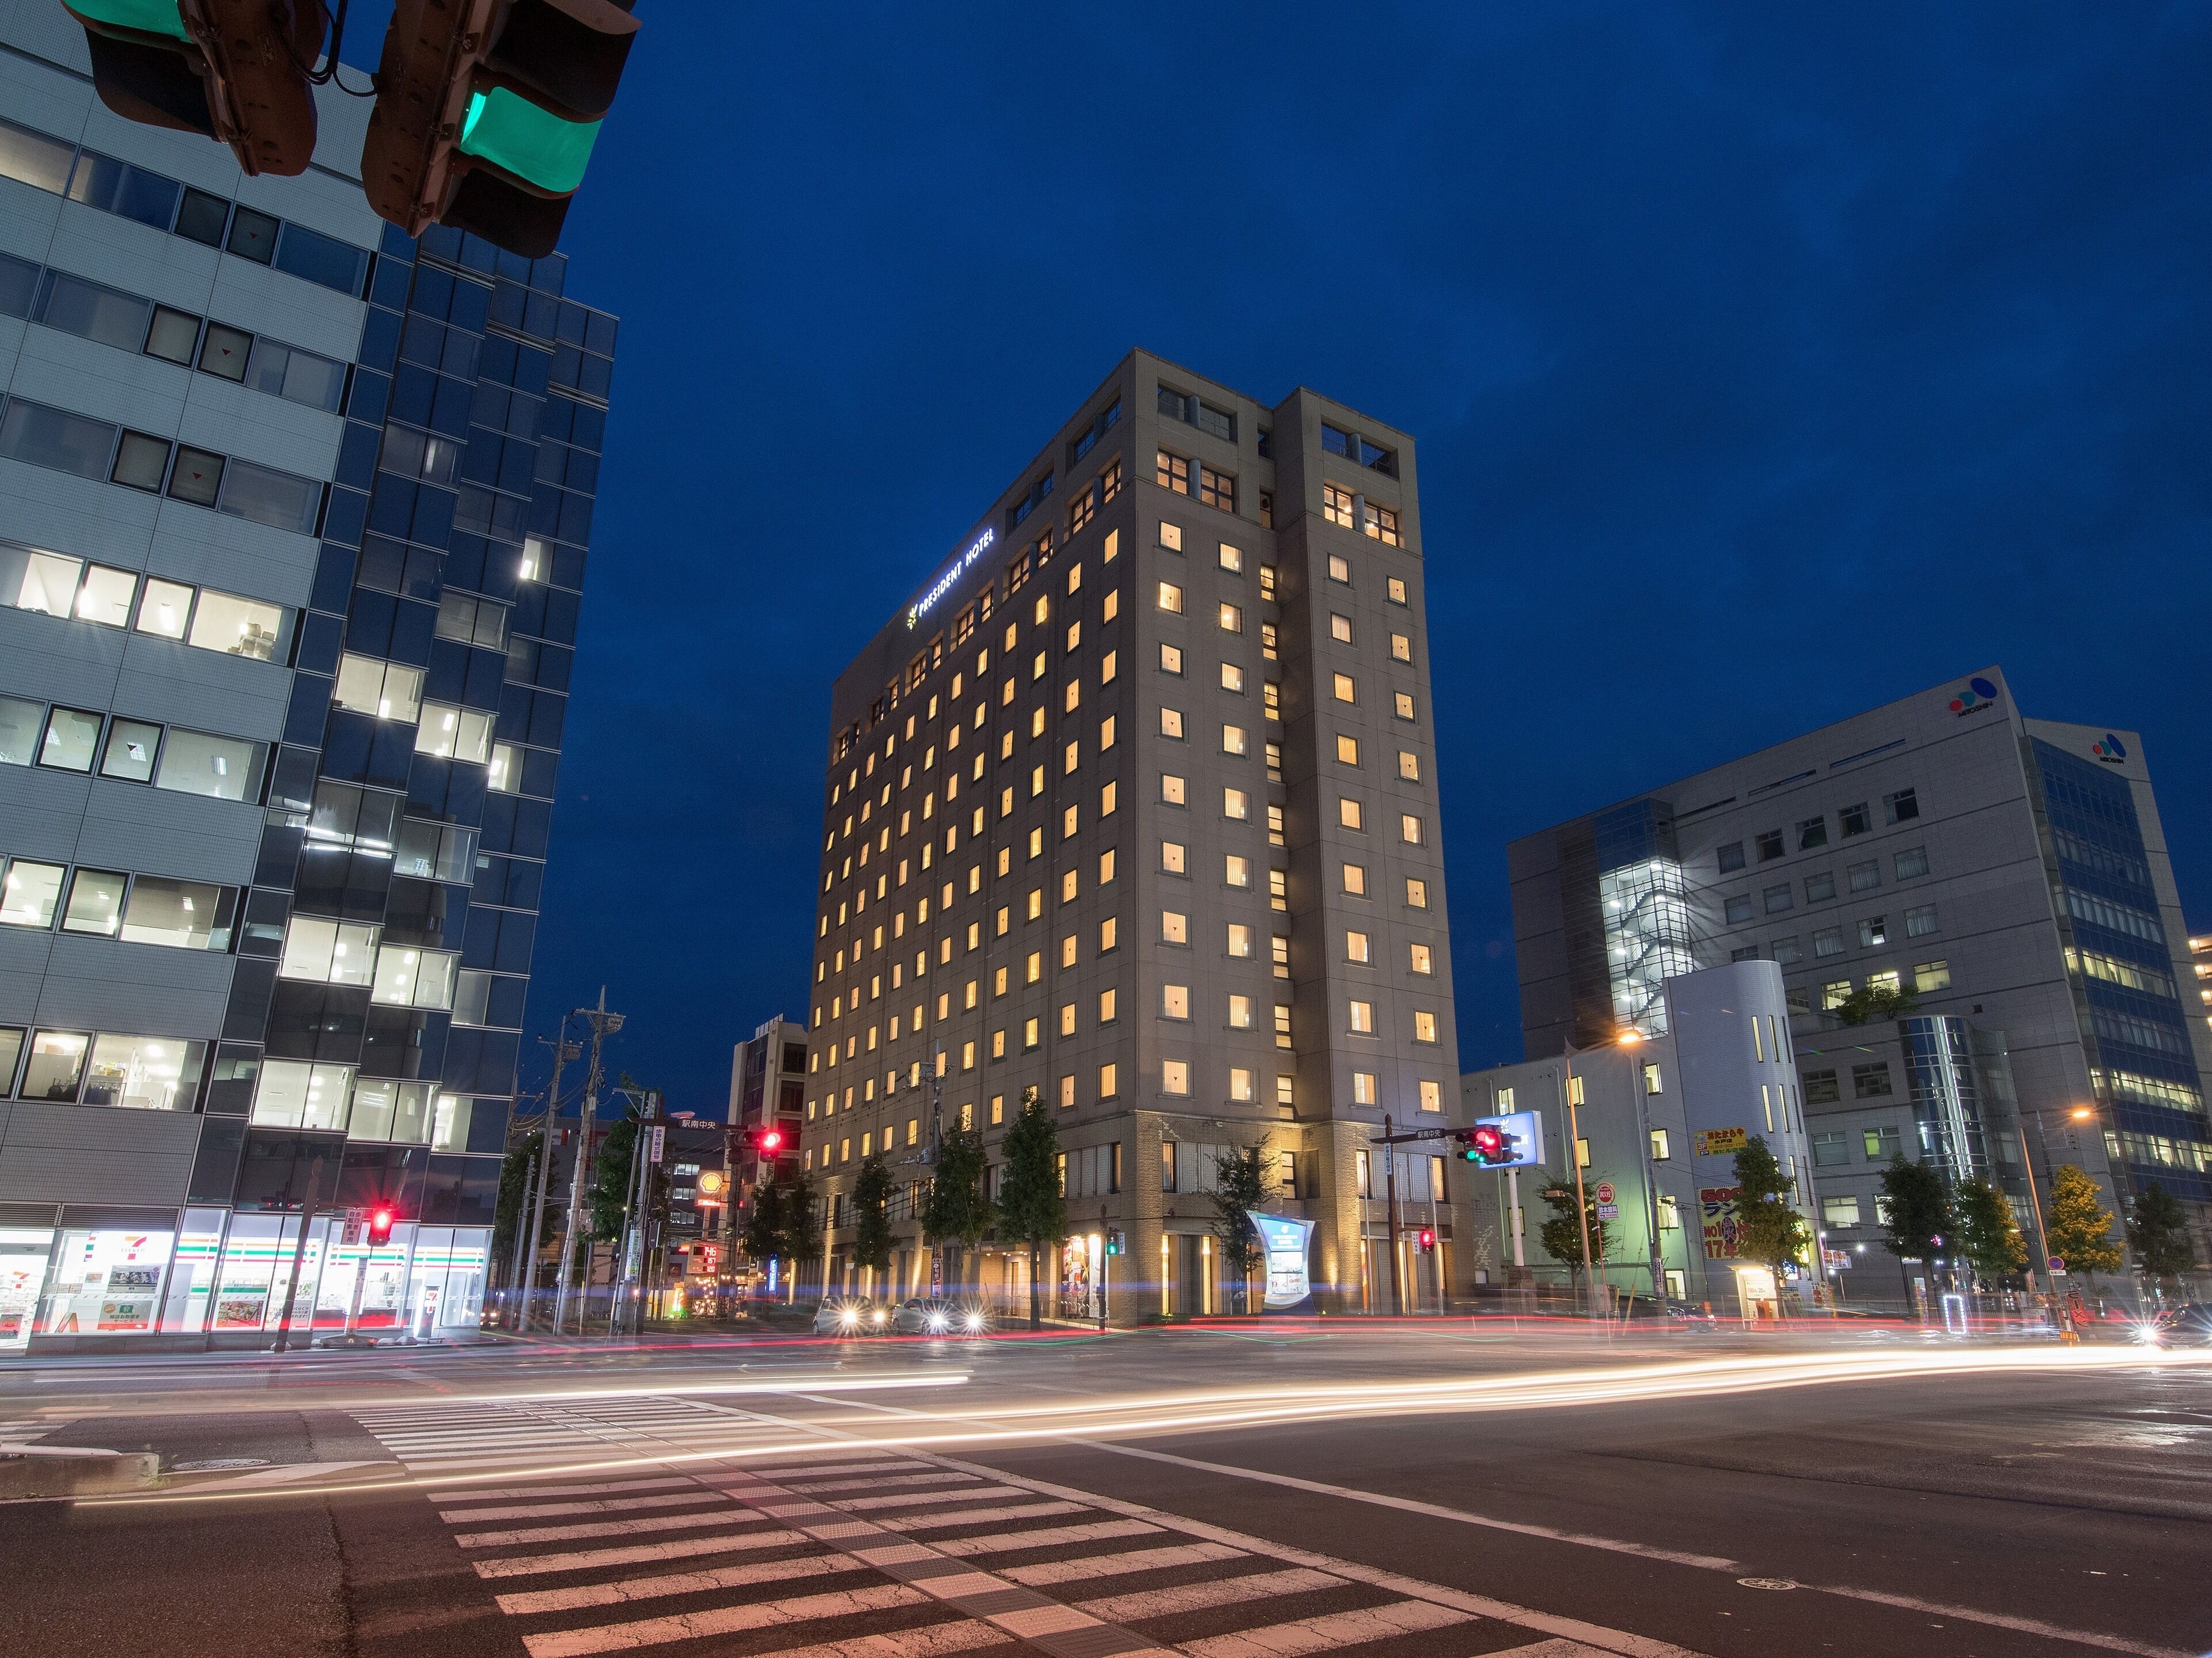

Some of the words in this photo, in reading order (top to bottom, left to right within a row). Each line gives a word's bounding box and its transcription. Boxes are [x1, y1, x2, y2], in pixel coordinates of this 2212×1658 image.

[919, 561, 961, 617] PRESIDENT
[965, 528, 993, 567] HOTEL
[1959, 701, 1993, 718] MITOSHIN
[681, 1119, 715, 1129] 駅南中央
[1418, 1129, 1441, 1139] 駅南中央
[704, 1247, 717, 1256] 146
